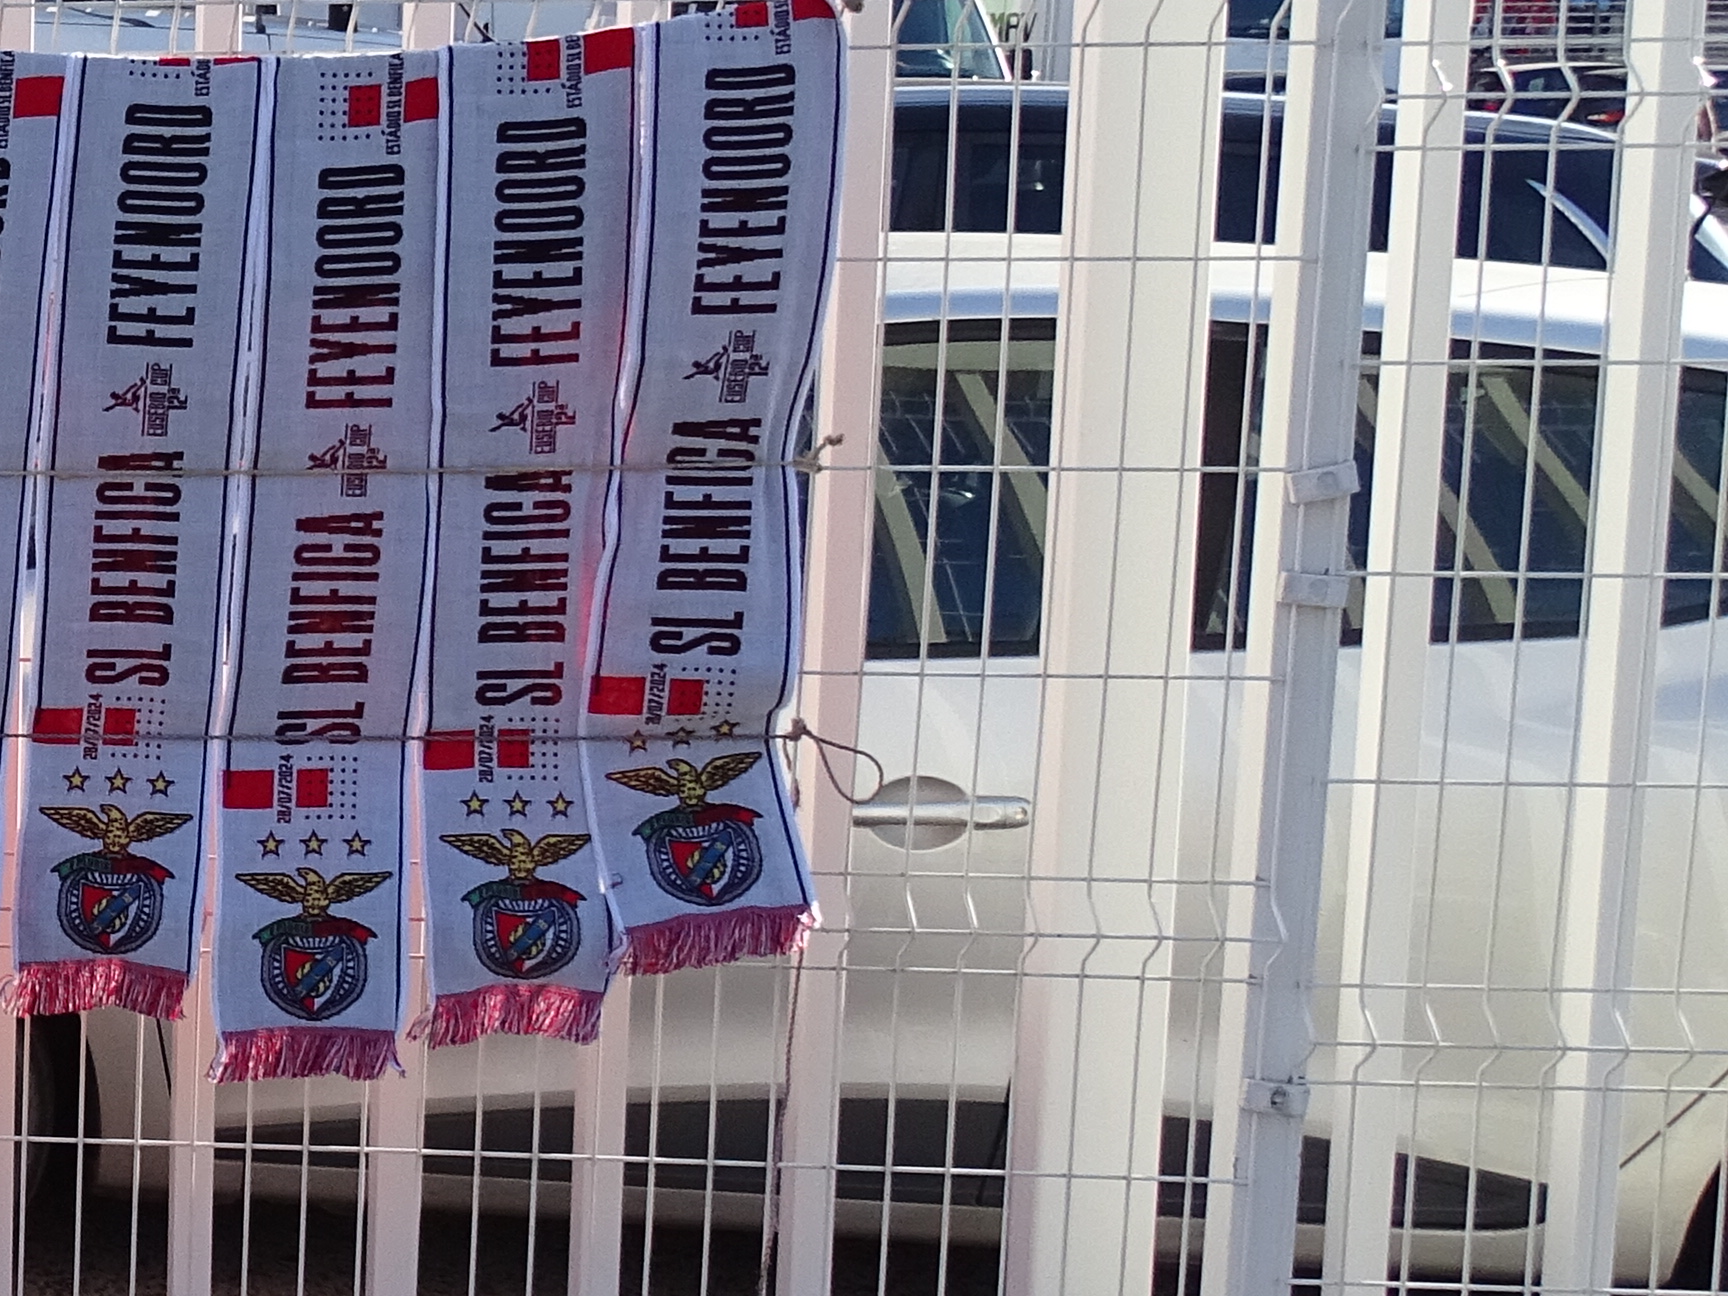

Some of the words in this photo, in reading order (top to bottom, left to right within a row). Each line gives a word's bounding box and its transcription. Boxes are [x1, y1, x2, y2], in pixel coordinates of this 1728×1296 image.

[106, 103, 213, 349] FEYENOORD
[490, 116, 588, 368] FEYENOORD
[690, 63, 796, 316] FEYENOORD
[305, 162, 405, 410] FEYENOORD
[88, 450, 185, 626] BENFICA
[478, 469, 574, 644] BENFICA
[655, 418, 763, 593] BENFICA
[85, 642, 172, 688] SL
[281, 509, 385, 685] BENFICA
[474, 660, 564, 707] SL
[649, 609, 745, 657] SL
[83, 693, 103, 761] 28/7/2024
[274, 700, 365, 745] SL
